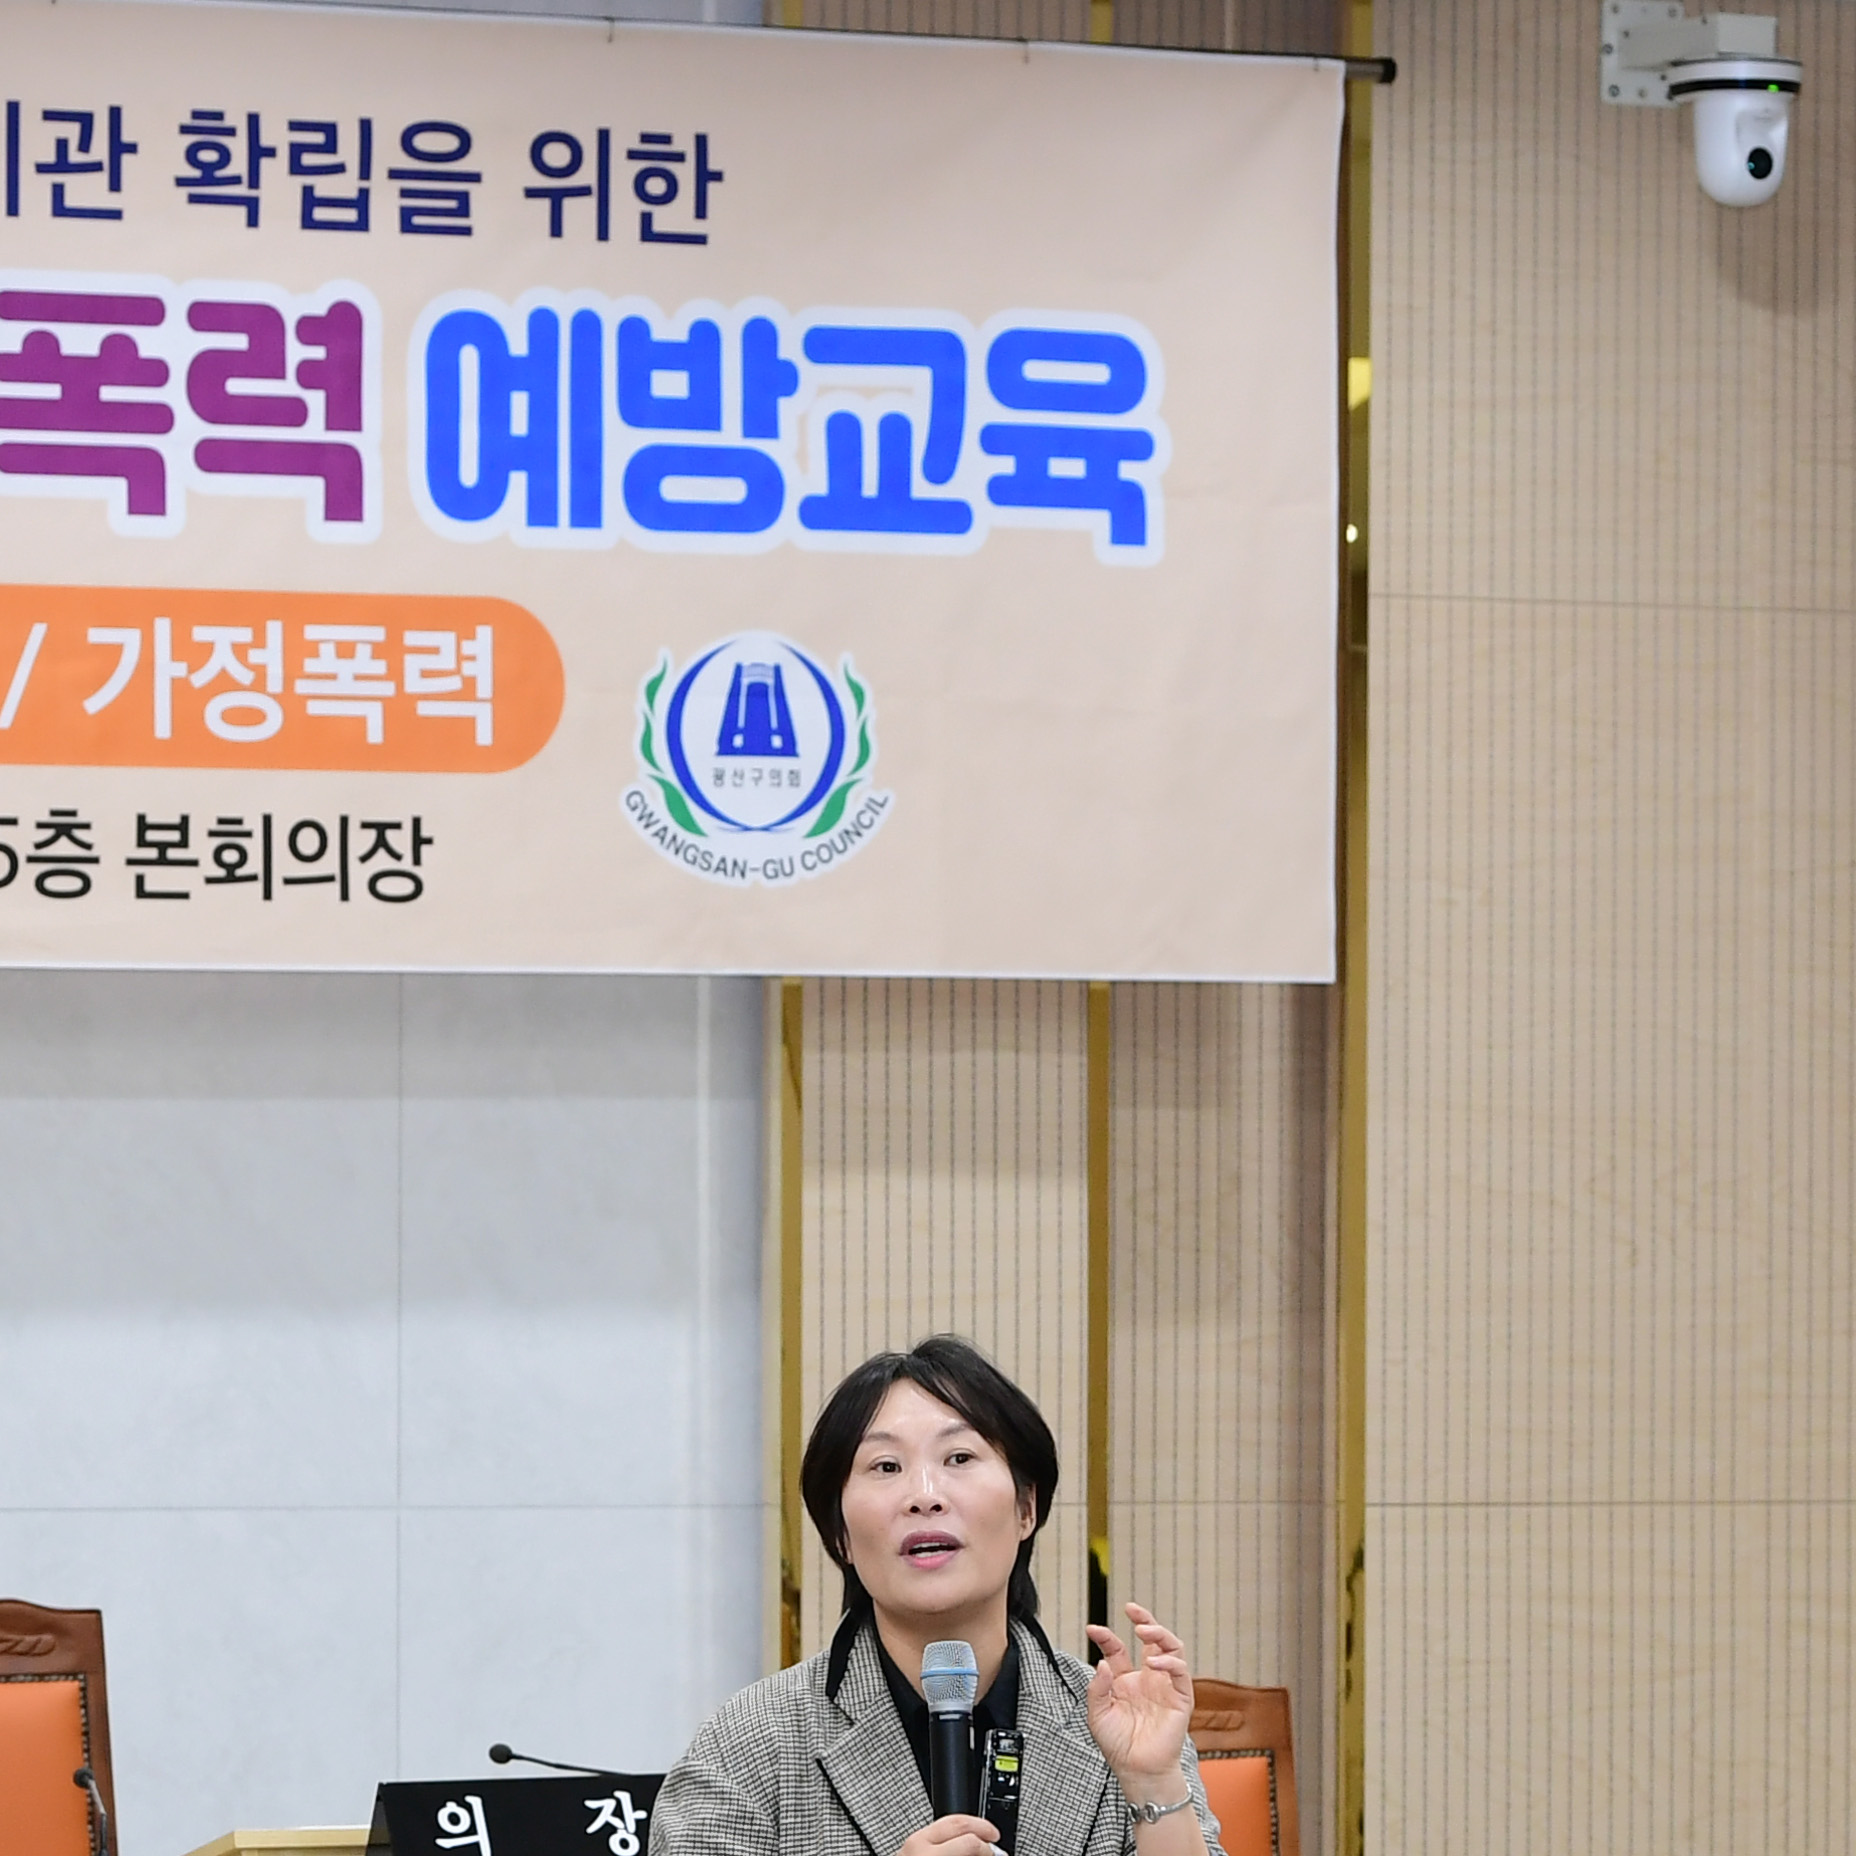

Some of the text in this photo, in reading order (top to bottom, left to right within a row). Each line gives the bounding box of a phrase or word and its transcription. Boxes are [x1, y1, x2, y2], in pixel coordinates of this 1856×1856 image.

[175, 110, 482, 236] 확립을
[524, 128, 723, 245] 위한
[426, 307, 1154, 546] 예방교육
[83, 617, 493, 746] 가정폭력
[713, 768, 801, 788] 광산구의회
[125, 814, 433, 903] 본회의장
[625, 790, 889, 880] GWANGSAN-GU COUNCIL
